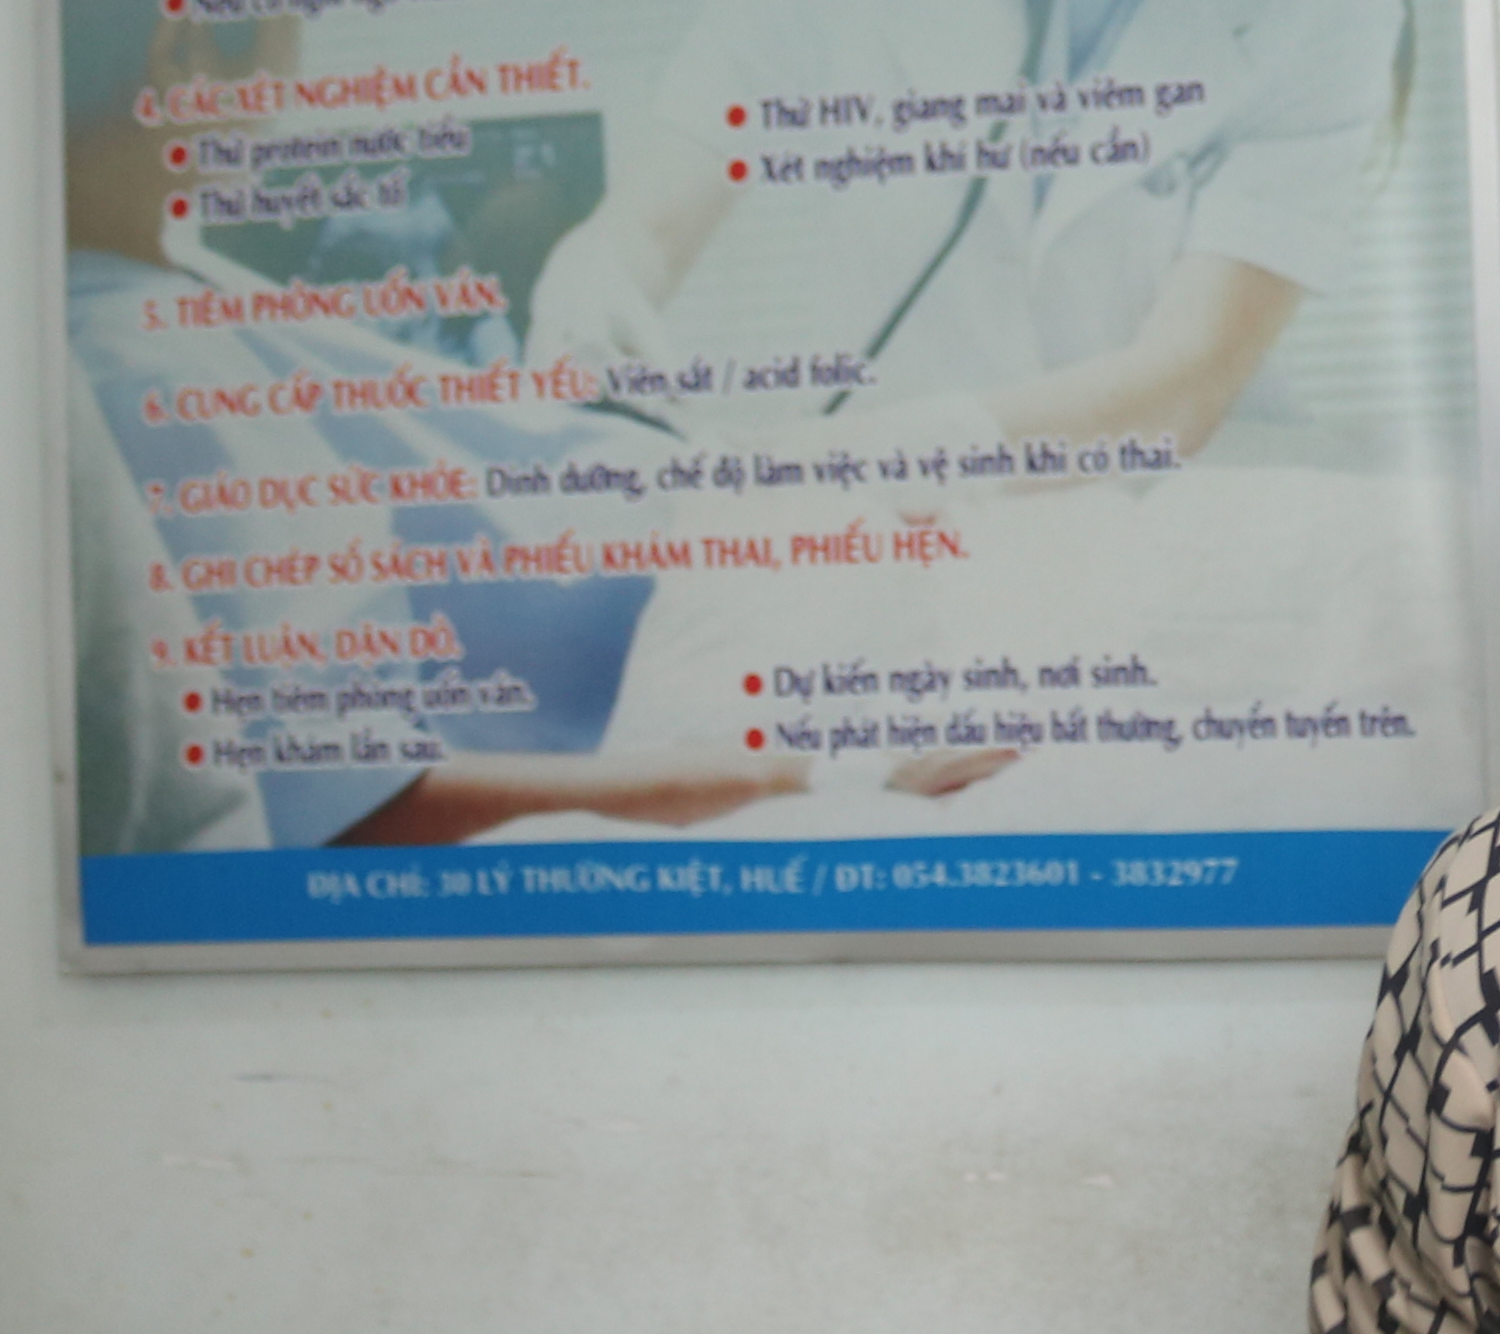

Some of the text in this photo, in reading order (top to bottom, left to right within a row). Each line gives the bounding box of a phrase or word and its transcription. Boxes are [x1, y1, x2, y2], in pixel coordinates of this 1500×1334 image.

[773, 666, 814, 702] Dự
[821, 659, 878, 694] kiến
[888, 661, 950, 701] ngày
[962, 656, 1027, 690] sinh,
[1090, 653, 1157, 687] sinh.
